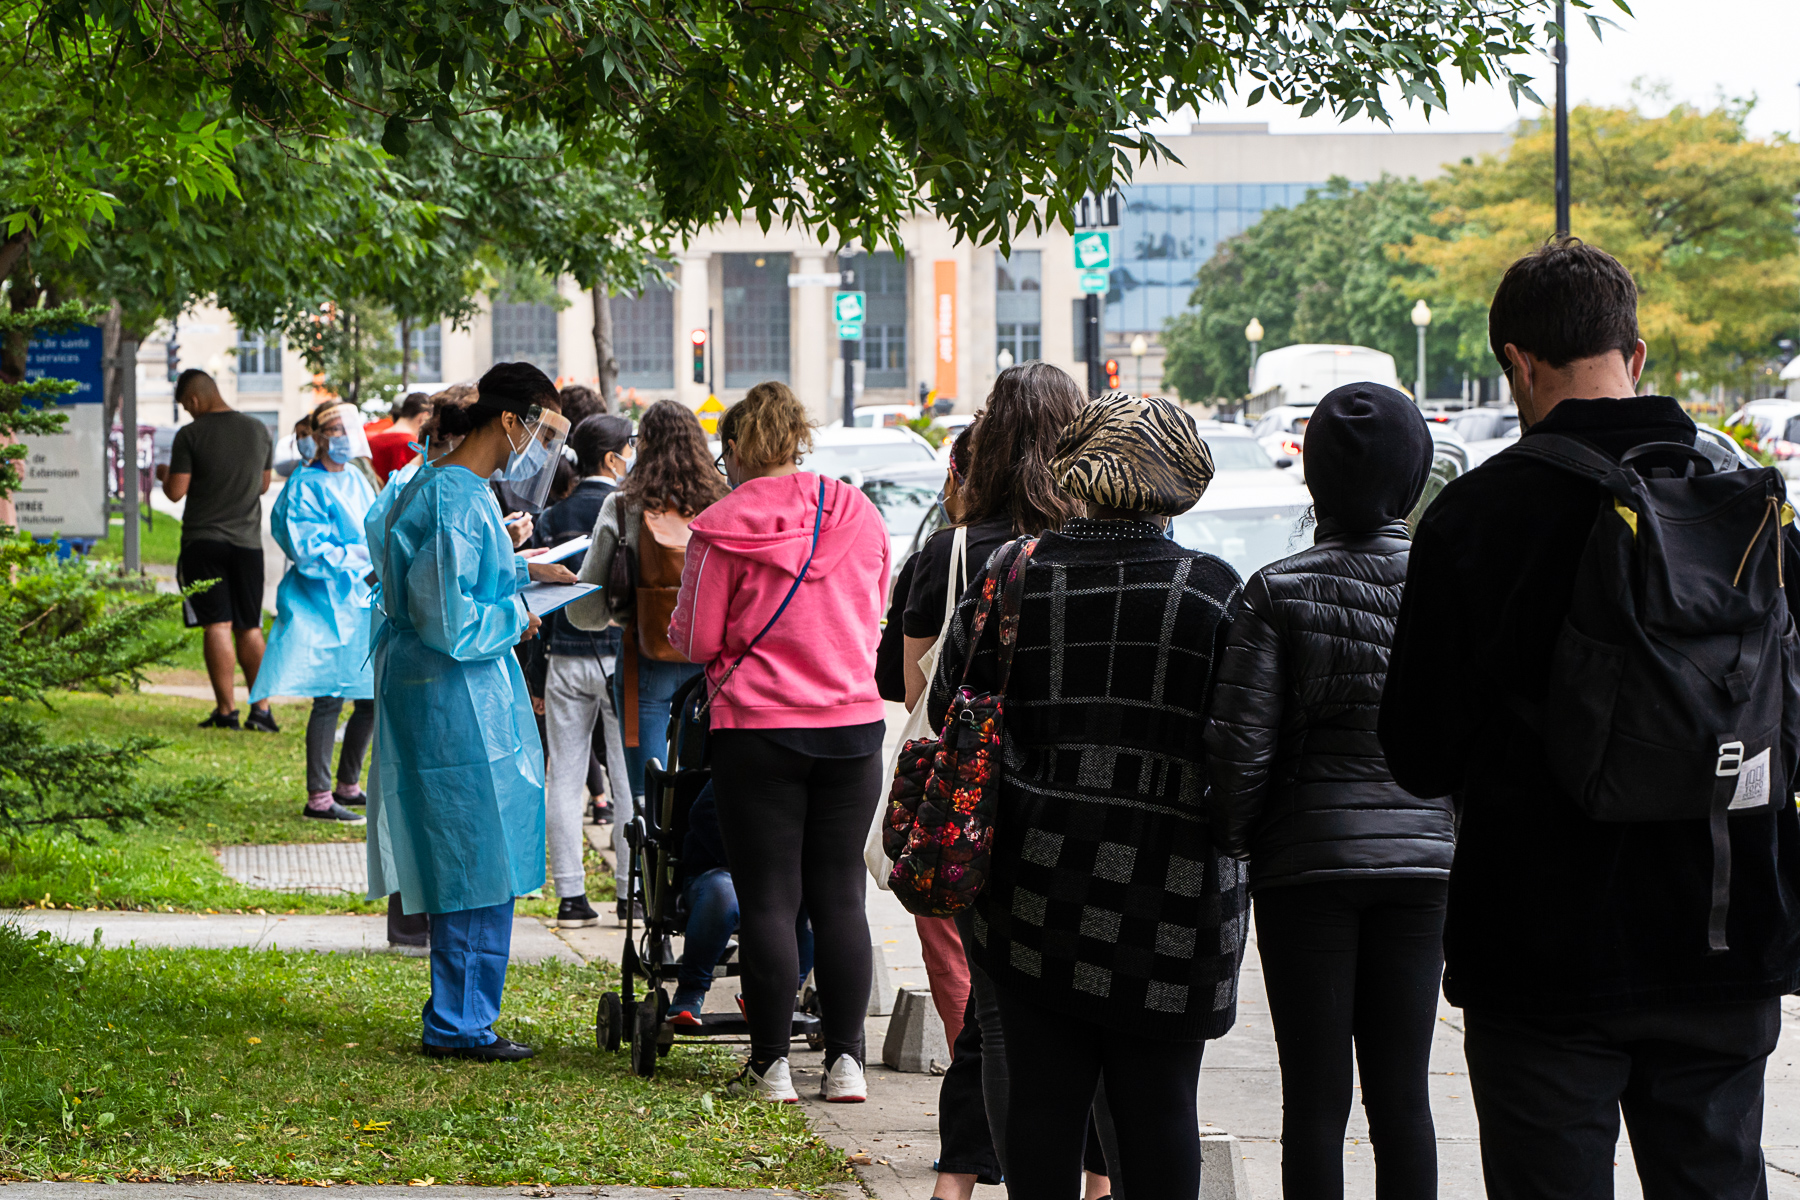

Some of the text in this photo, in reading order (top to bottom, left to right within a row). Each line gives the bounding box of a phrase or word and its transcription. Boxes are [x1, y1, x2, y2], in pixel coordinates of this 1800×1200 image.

[60, 337, 91, 349] santé
[35, 353, 80, 363] services
[29, 466, 79, 478] Extension
